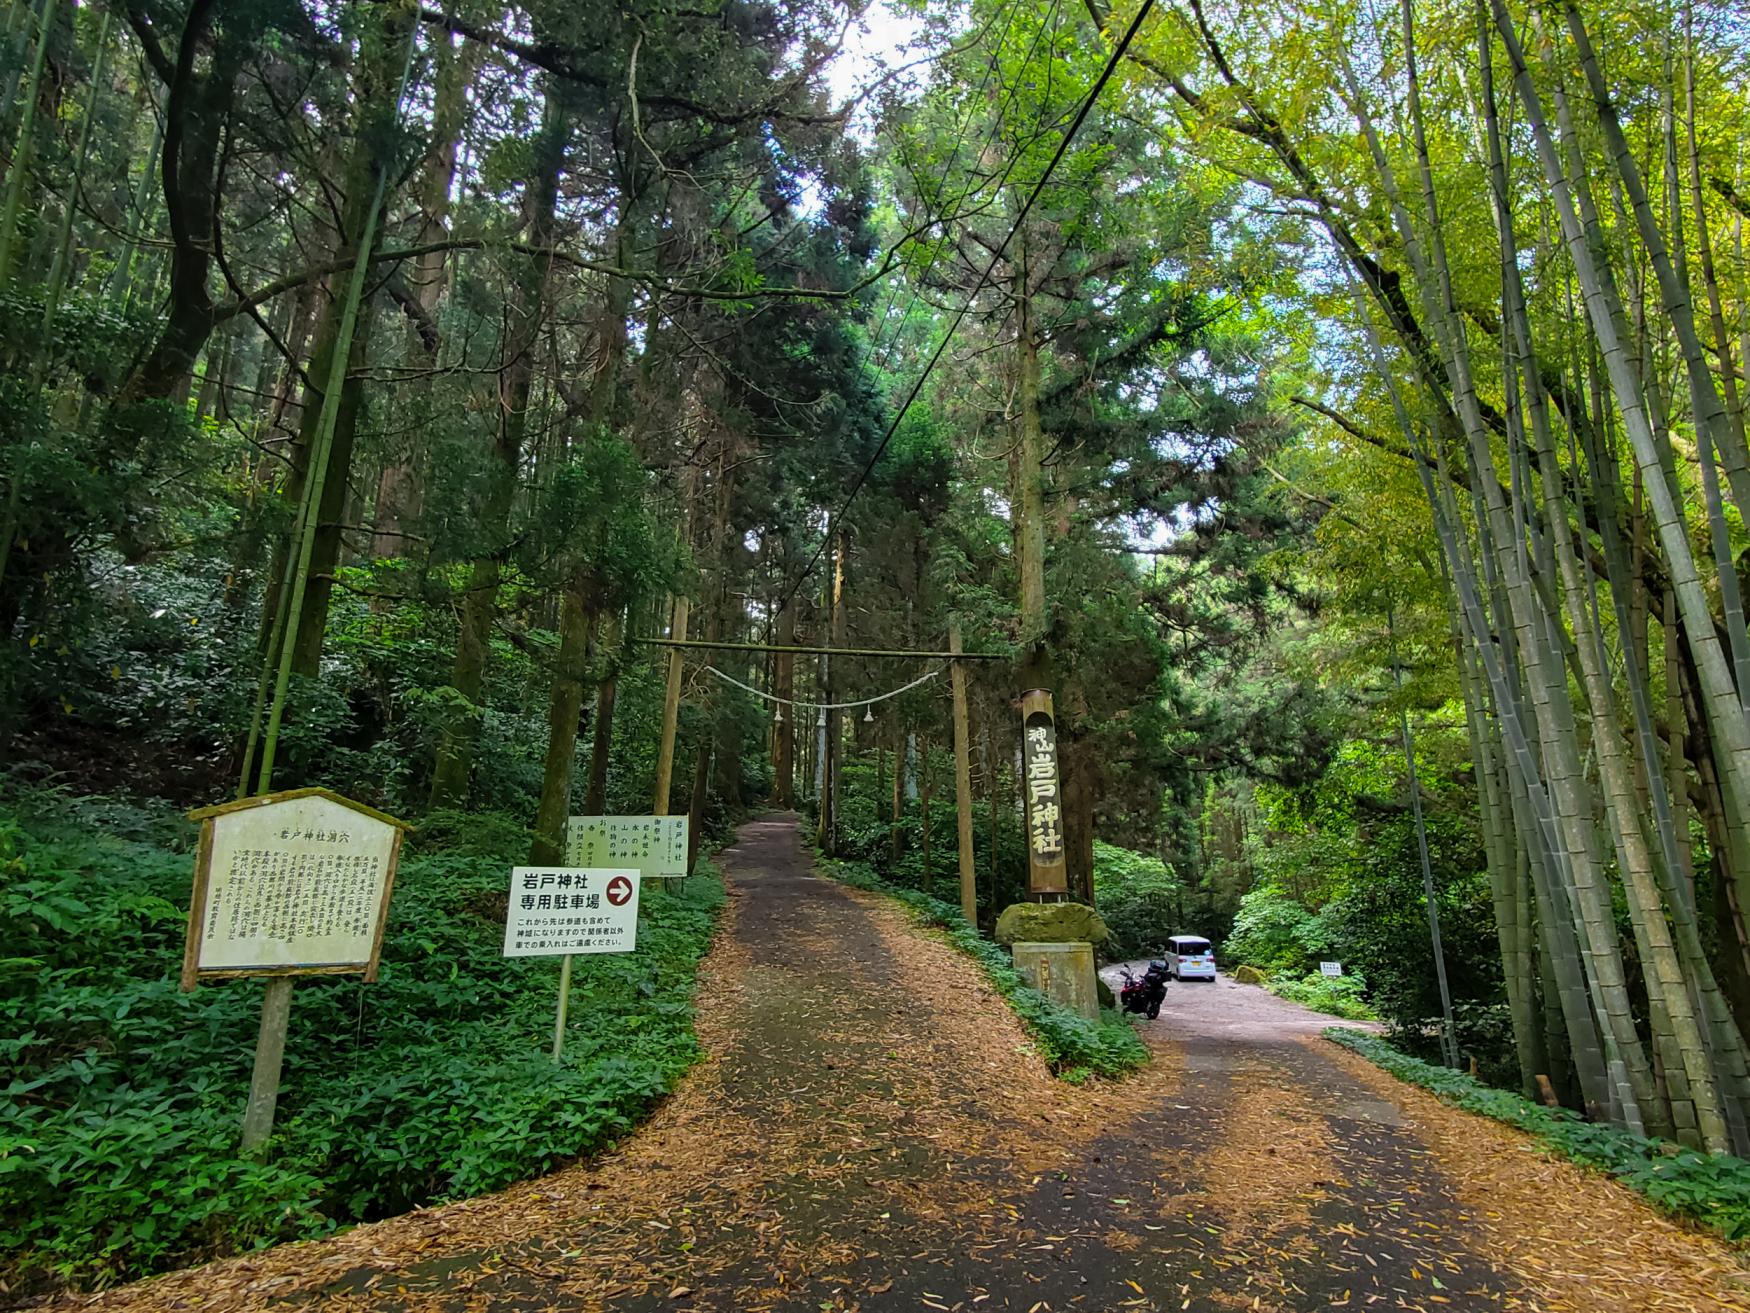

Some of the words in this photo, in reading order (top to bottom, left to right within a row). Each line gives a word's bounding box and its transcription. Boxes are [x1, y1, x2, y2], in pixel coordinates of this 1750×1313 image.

[620, 825, 628, 857] 山の神
[522, 873, 589, 889] 岩戸神社
[520, 893, 600, 910] 専用駐車場
[517, 916, 611, 926] これから先は参道も含めて
[516, 926, 625, 938] 神域になりますので関係者以外
[515, 938, 622, 949] 車での乗入れはご遠慮ください。
